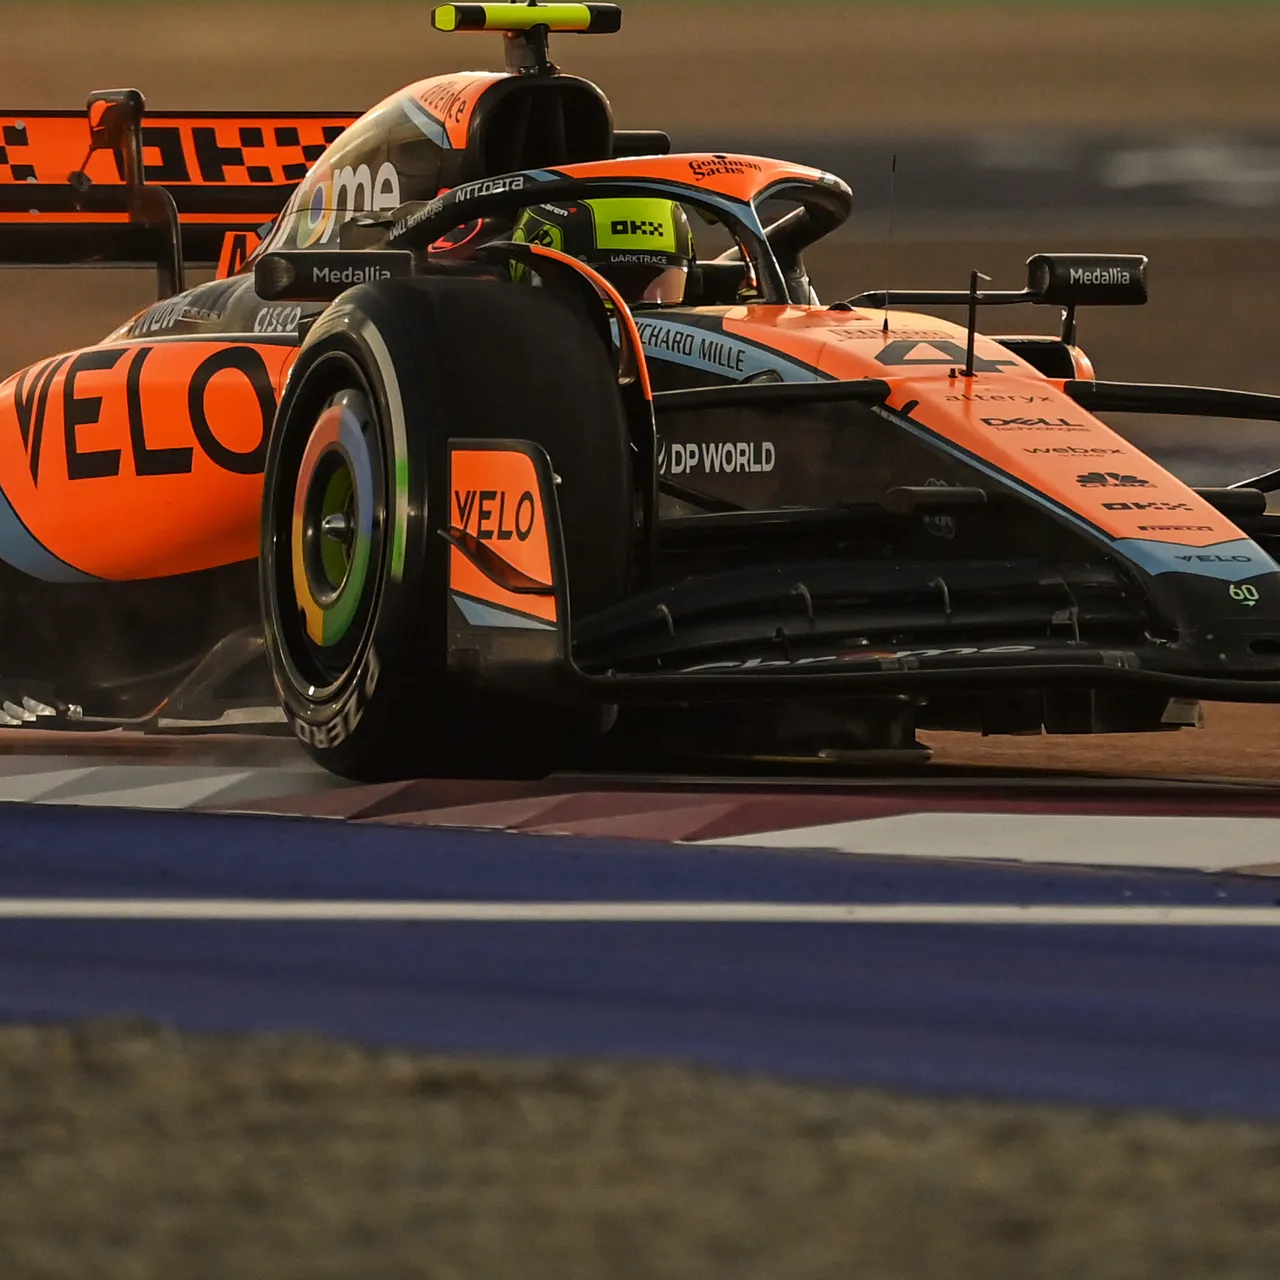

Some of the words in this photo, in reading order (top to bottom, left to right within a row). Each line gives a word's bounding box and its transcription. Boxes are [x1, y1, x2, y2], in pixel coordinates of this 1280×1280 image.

[688, 160, 762, 172] Goldman
[692, 166, 744, 181] Sachs
[611, 220, 663, 237] OKX
[312, 266, 391, 284] Medallia
[1070, 268, 1130, 284] Medallia
[254, 306, 302, 333] CISCO
[698, 338, 746, 372] MILLE
[874, 340, 1019, 373] 4
[14, 346, 277, 489] VELO
[670, 443, 700, 474] DP
[702, 441, 776, 473] WORLD
[454, 489, 536, 542] VELO
[1229, 584, 1260, 600] 60
